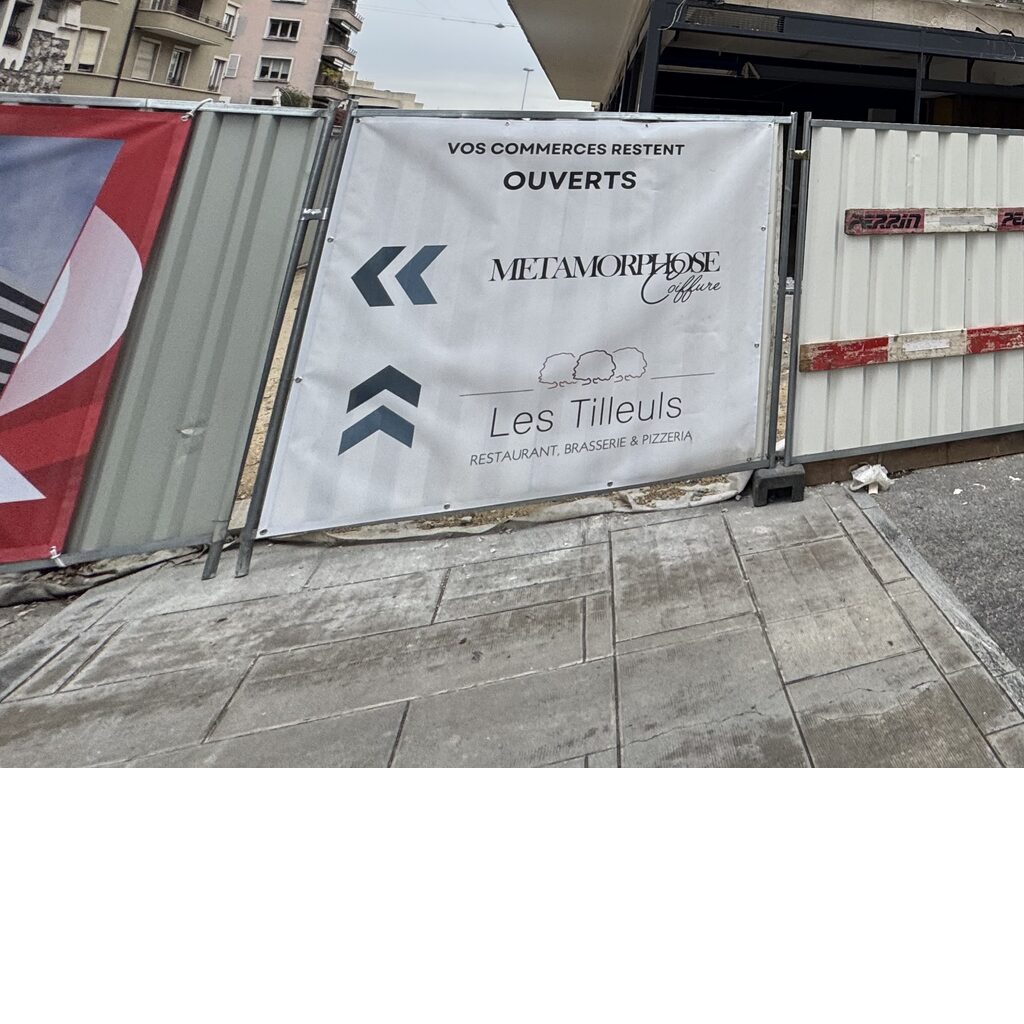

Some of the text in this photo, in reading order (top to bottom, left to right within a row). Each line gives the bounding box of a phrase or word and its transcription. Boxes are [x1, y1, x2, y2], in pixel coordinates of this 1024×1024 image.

[448, 142, 685, 156] VOS COMMERCES RESTENT
[503, 170, 637, 191] OUVERTS
[489, 251, 721, 282] METAMORPHOSE
[641, 258, 721, 305] Coiffure
[490, 391, 682, 438] Les Tilleuls
[469, 430, 693, 466] RESTAURANT, BRASSERIE & PIZZERIA
